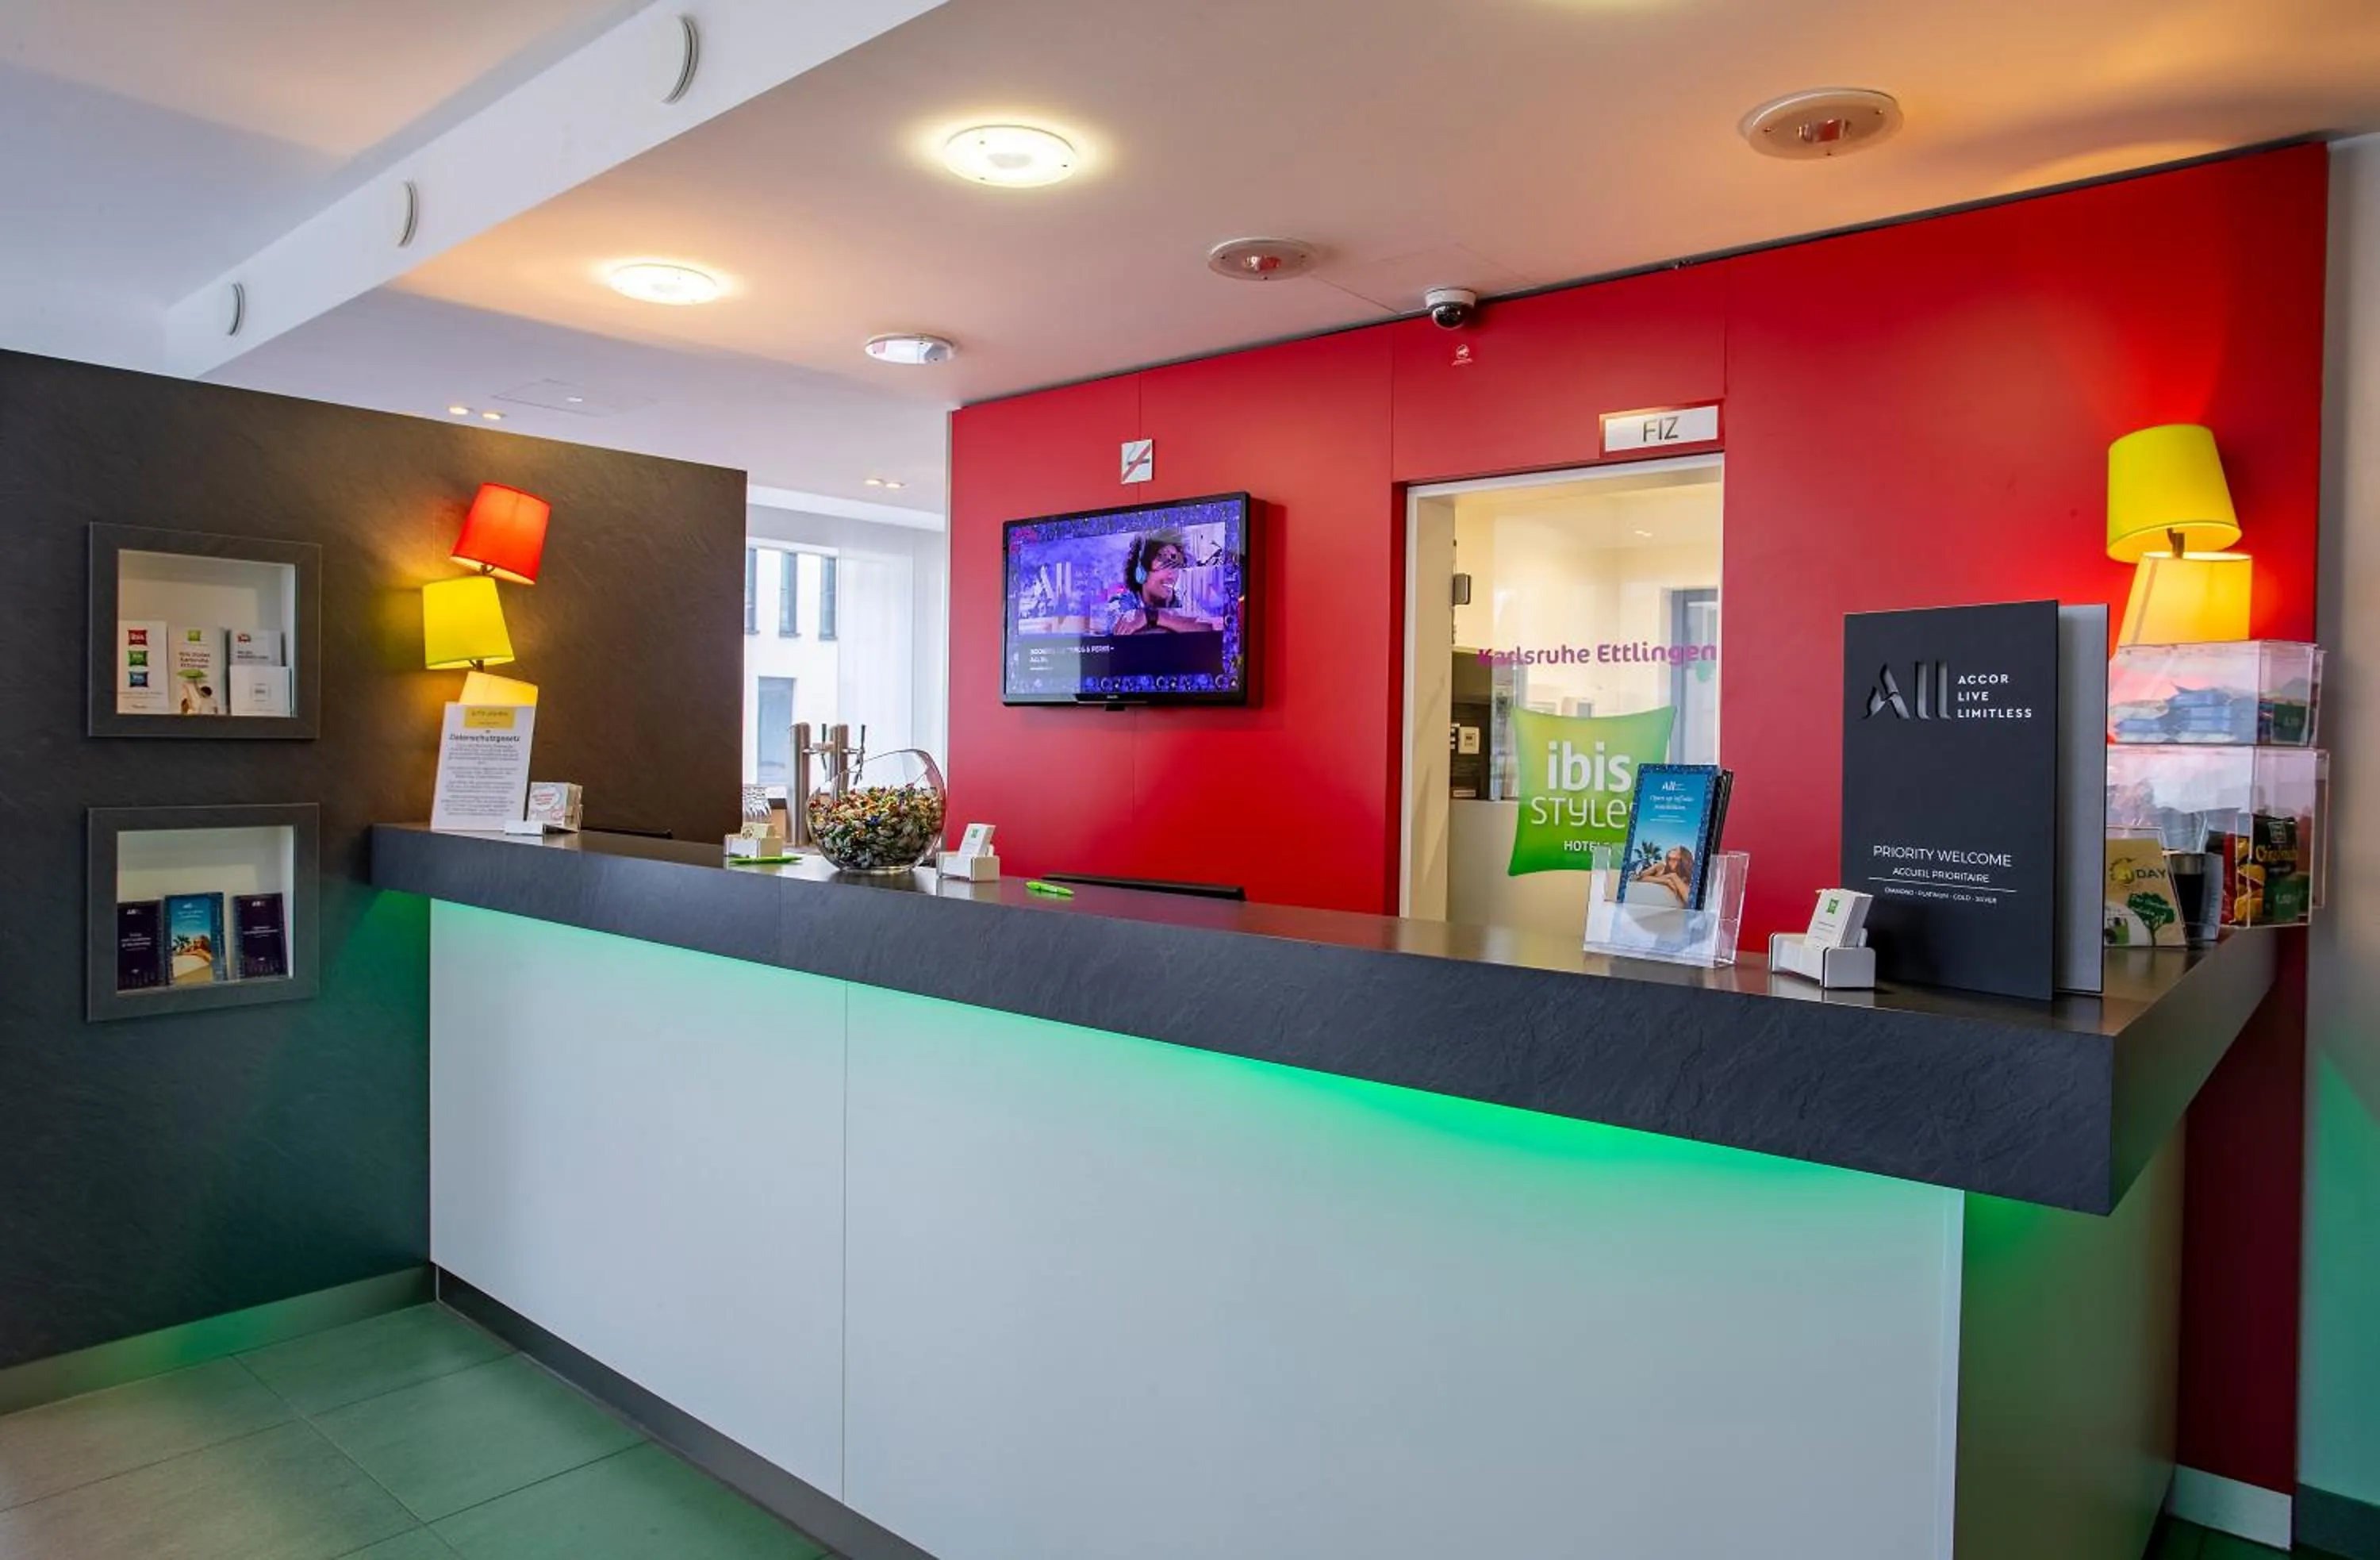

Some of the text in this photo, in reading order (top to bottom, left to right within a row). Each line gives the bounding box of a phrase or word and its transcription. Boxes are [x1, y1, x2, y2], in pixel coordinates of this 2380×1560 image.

[1642, 416, 1679, 443] FIZ
[1478, 640, 1718, 666] Karlsruhe Ettlingen
[1957, 673, 2010, 685] ACCOR
[1957, 691, 1990, 702] LIVE
[1957, 708, 2033, 719] LIMITLESS
[1548, 740, 1632, 793] ibis
[1530, 796, 1634, 828] STYLE
[1564, 840, 1610, 852] HOTE
[1873, 845, 2013, 867] PRIORITY WELCOME
[1892, 867, 1990, 883] ACCUEIL PRIORITAIRE
